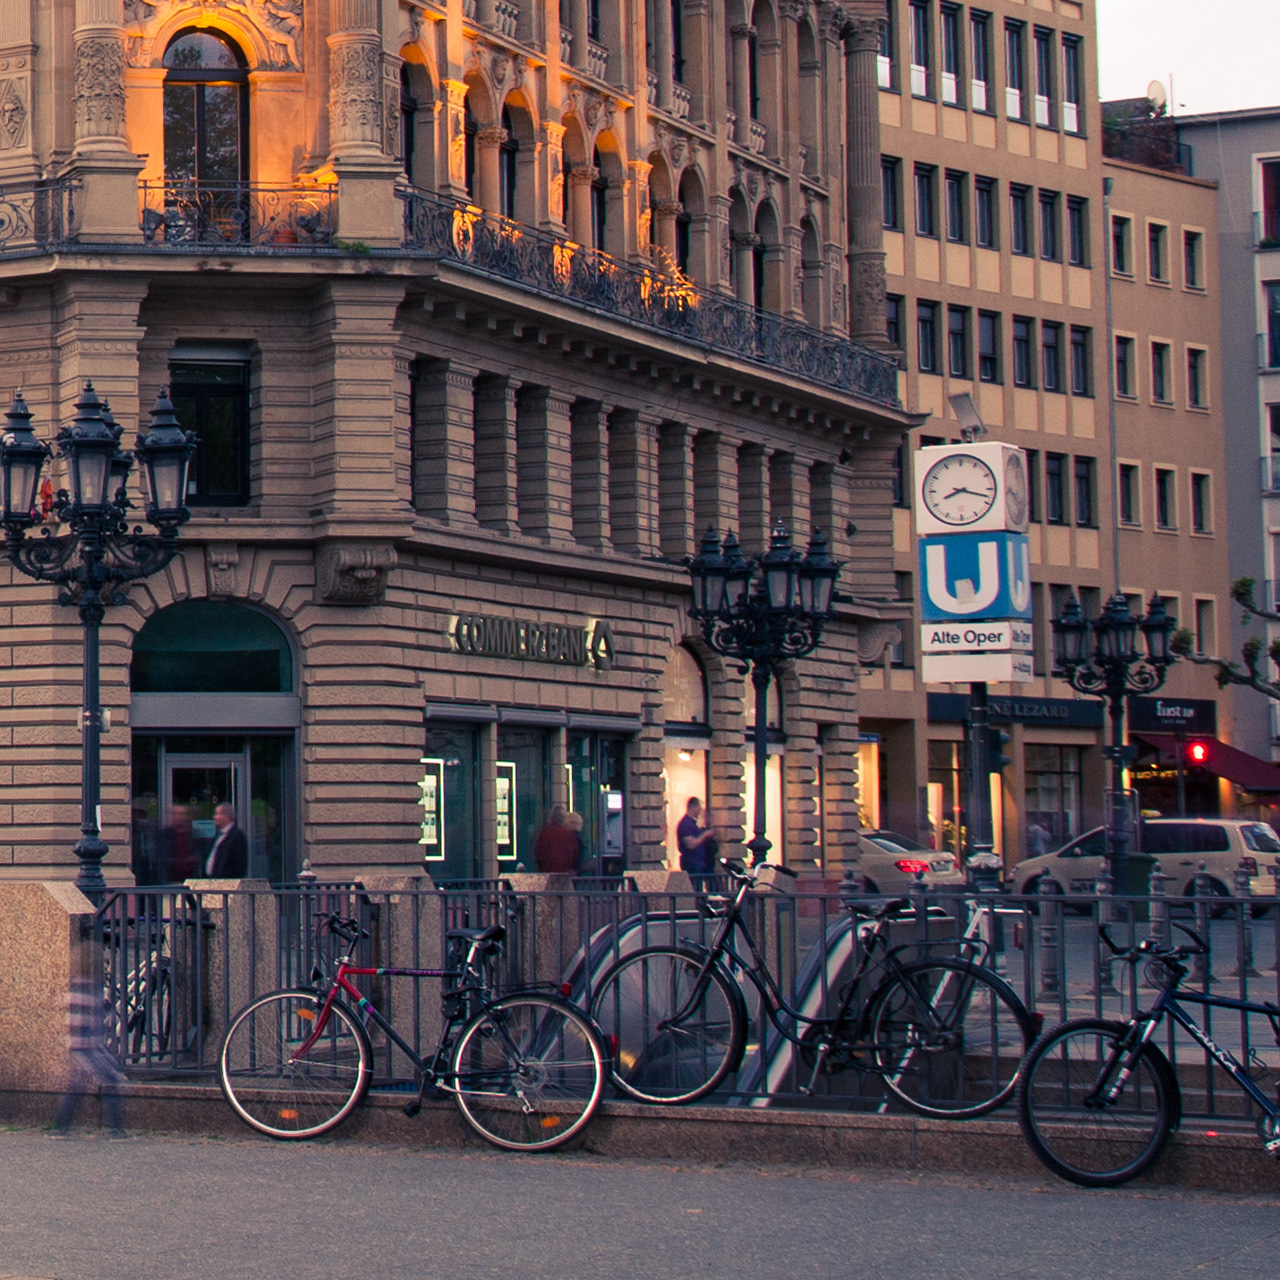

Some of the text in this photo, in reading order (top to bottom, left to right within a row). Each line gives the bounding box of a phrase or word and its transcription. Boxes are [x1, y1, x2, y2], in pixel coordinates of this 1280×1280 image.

[925, 541, 999, 615] U
[1007, 541, 1030, 612] U
[930, 630, 1003, 646] Alte Oper
